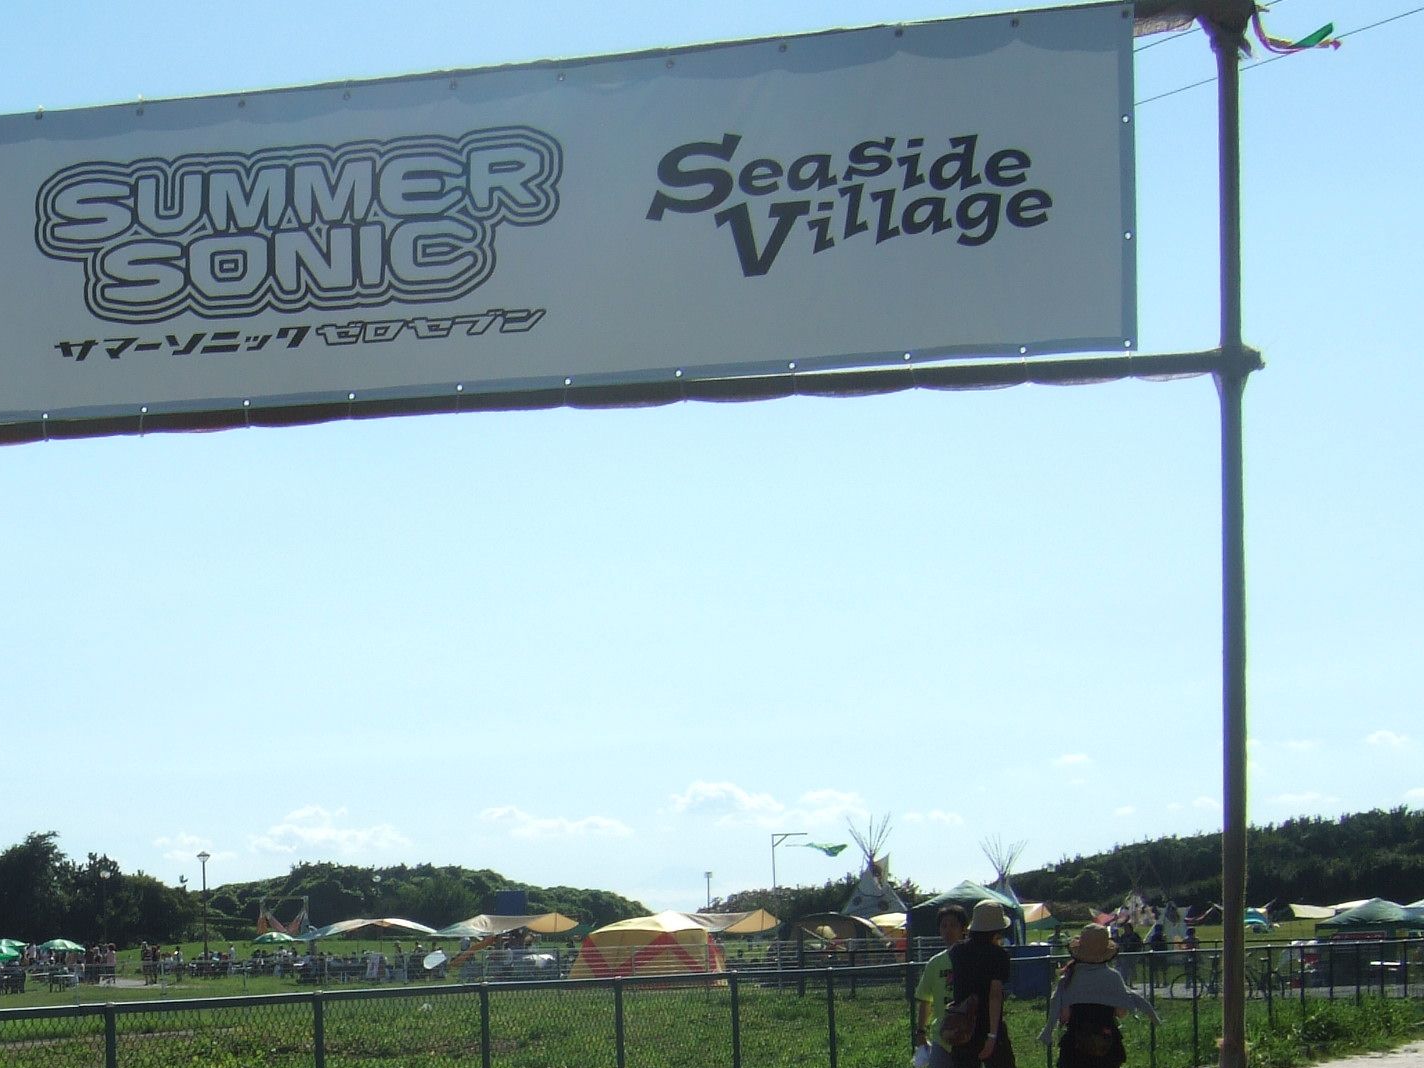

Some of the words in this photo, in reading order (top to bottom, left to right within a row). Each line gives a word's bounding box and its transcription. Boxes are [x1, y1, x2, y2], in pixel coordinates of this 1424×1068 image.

[40, 130, 558, 253] SUMMER
[645, 133, 1032, 221] Seaside
[90, 215, 492, 313] SONIC
[714, 188, 1053, 277] Village
